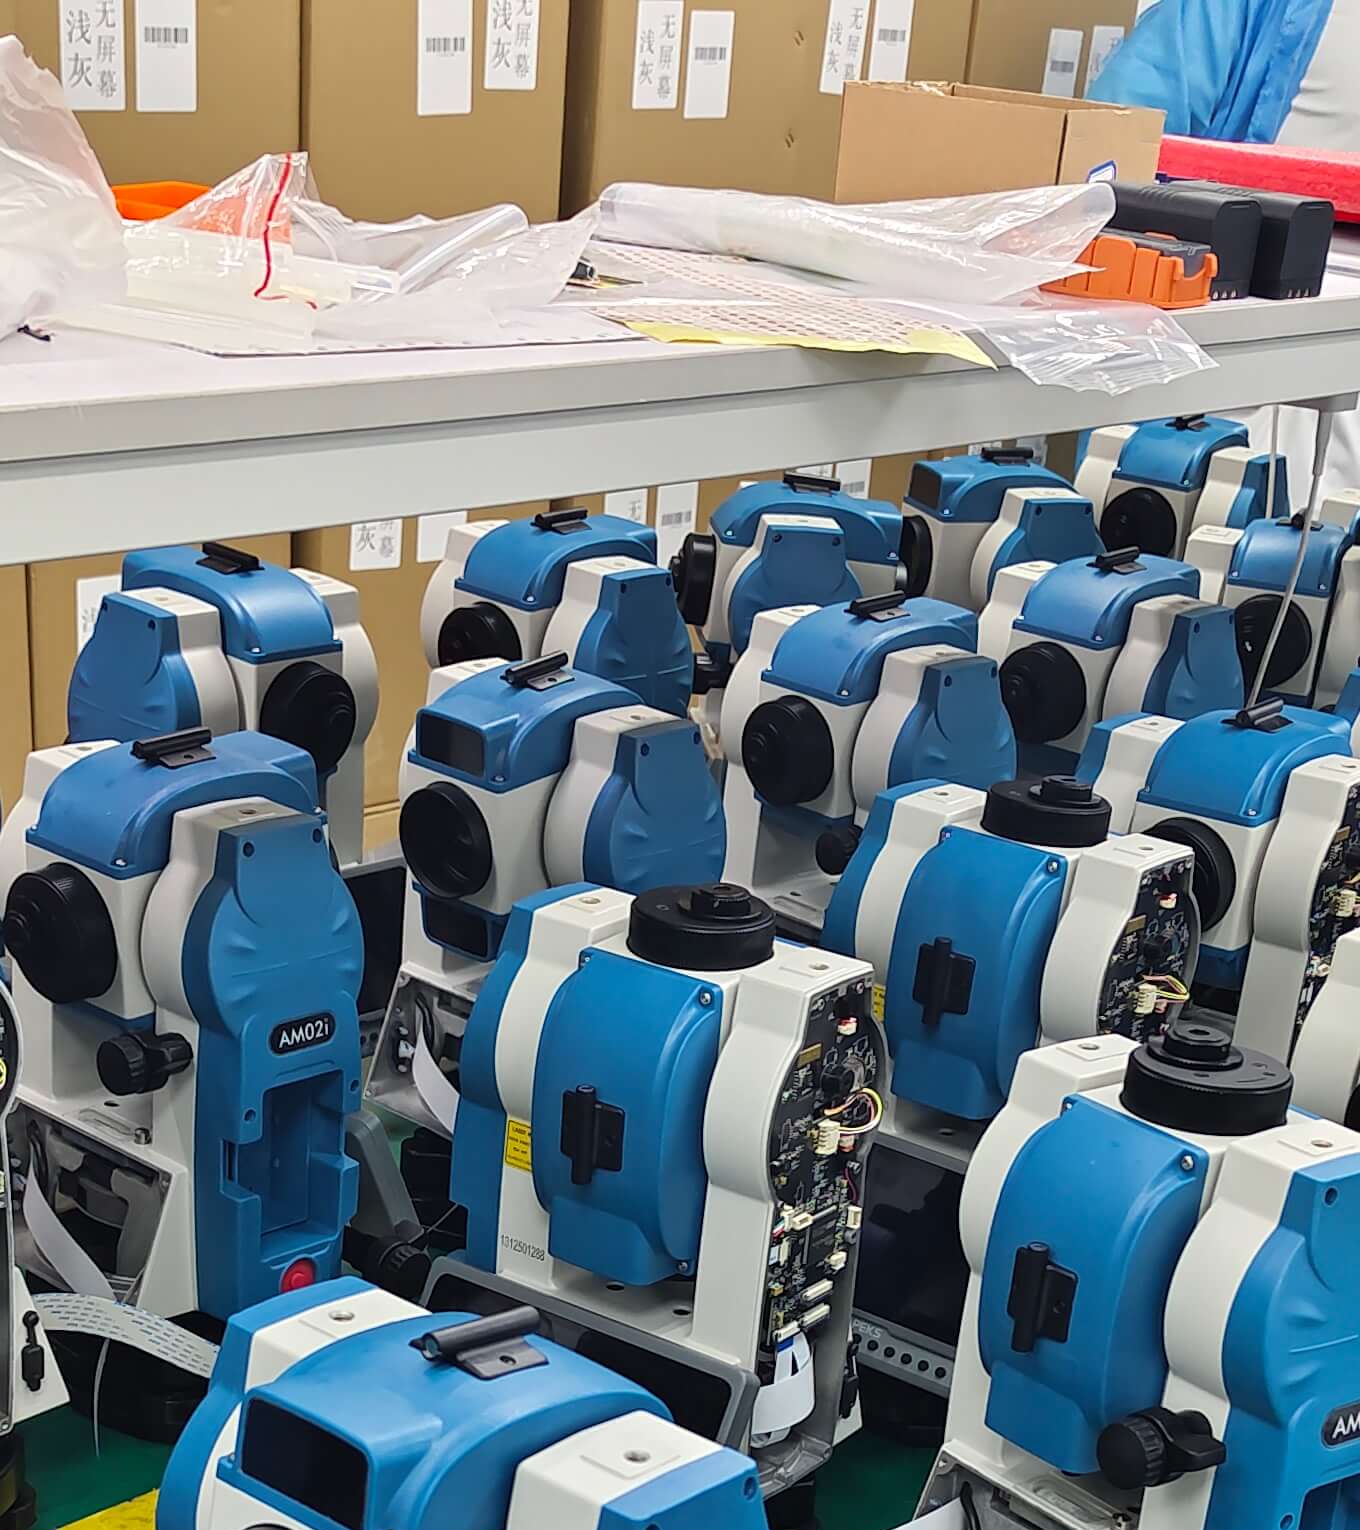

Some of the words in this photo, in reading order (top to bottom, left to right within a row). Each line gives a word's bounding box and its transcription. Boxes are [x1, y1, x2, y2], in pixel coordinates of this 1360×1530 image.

[66, 9, 92, 88] 浅灰
[96, 0, 117, 98] 无屏幕
[492, 0, 512, 69] 浅灰
[278, 1017, 330, 1049] AM02i
[852, 1318, 884, 1338] PEKS
